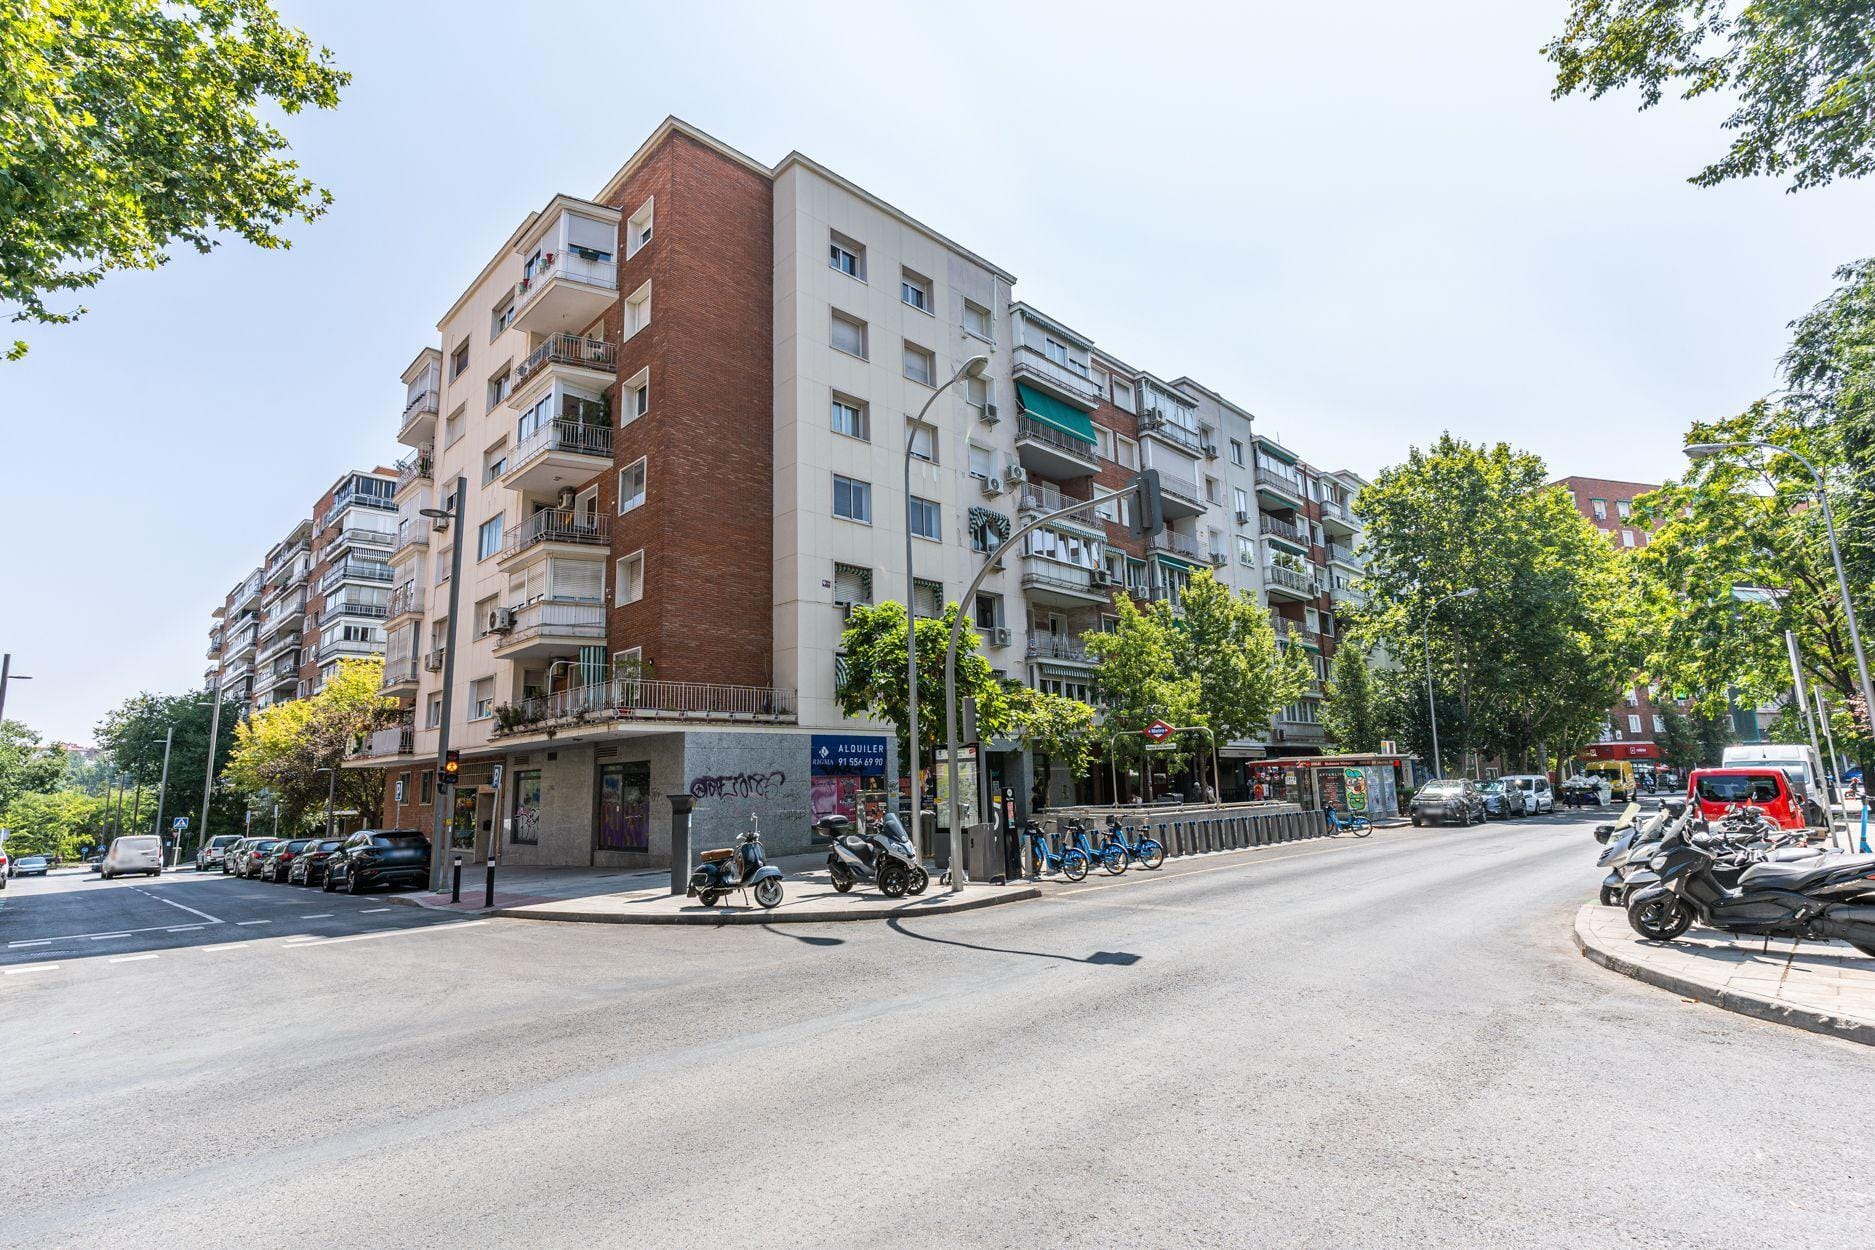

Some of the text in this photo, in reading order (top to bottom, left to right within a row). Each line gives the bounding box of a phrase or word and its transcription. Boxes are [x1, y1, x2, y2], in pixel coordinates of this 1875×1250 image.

[838, 744, 884, 753] ALQUILER
[838, 758, 883, 766] 91 556 69 90
